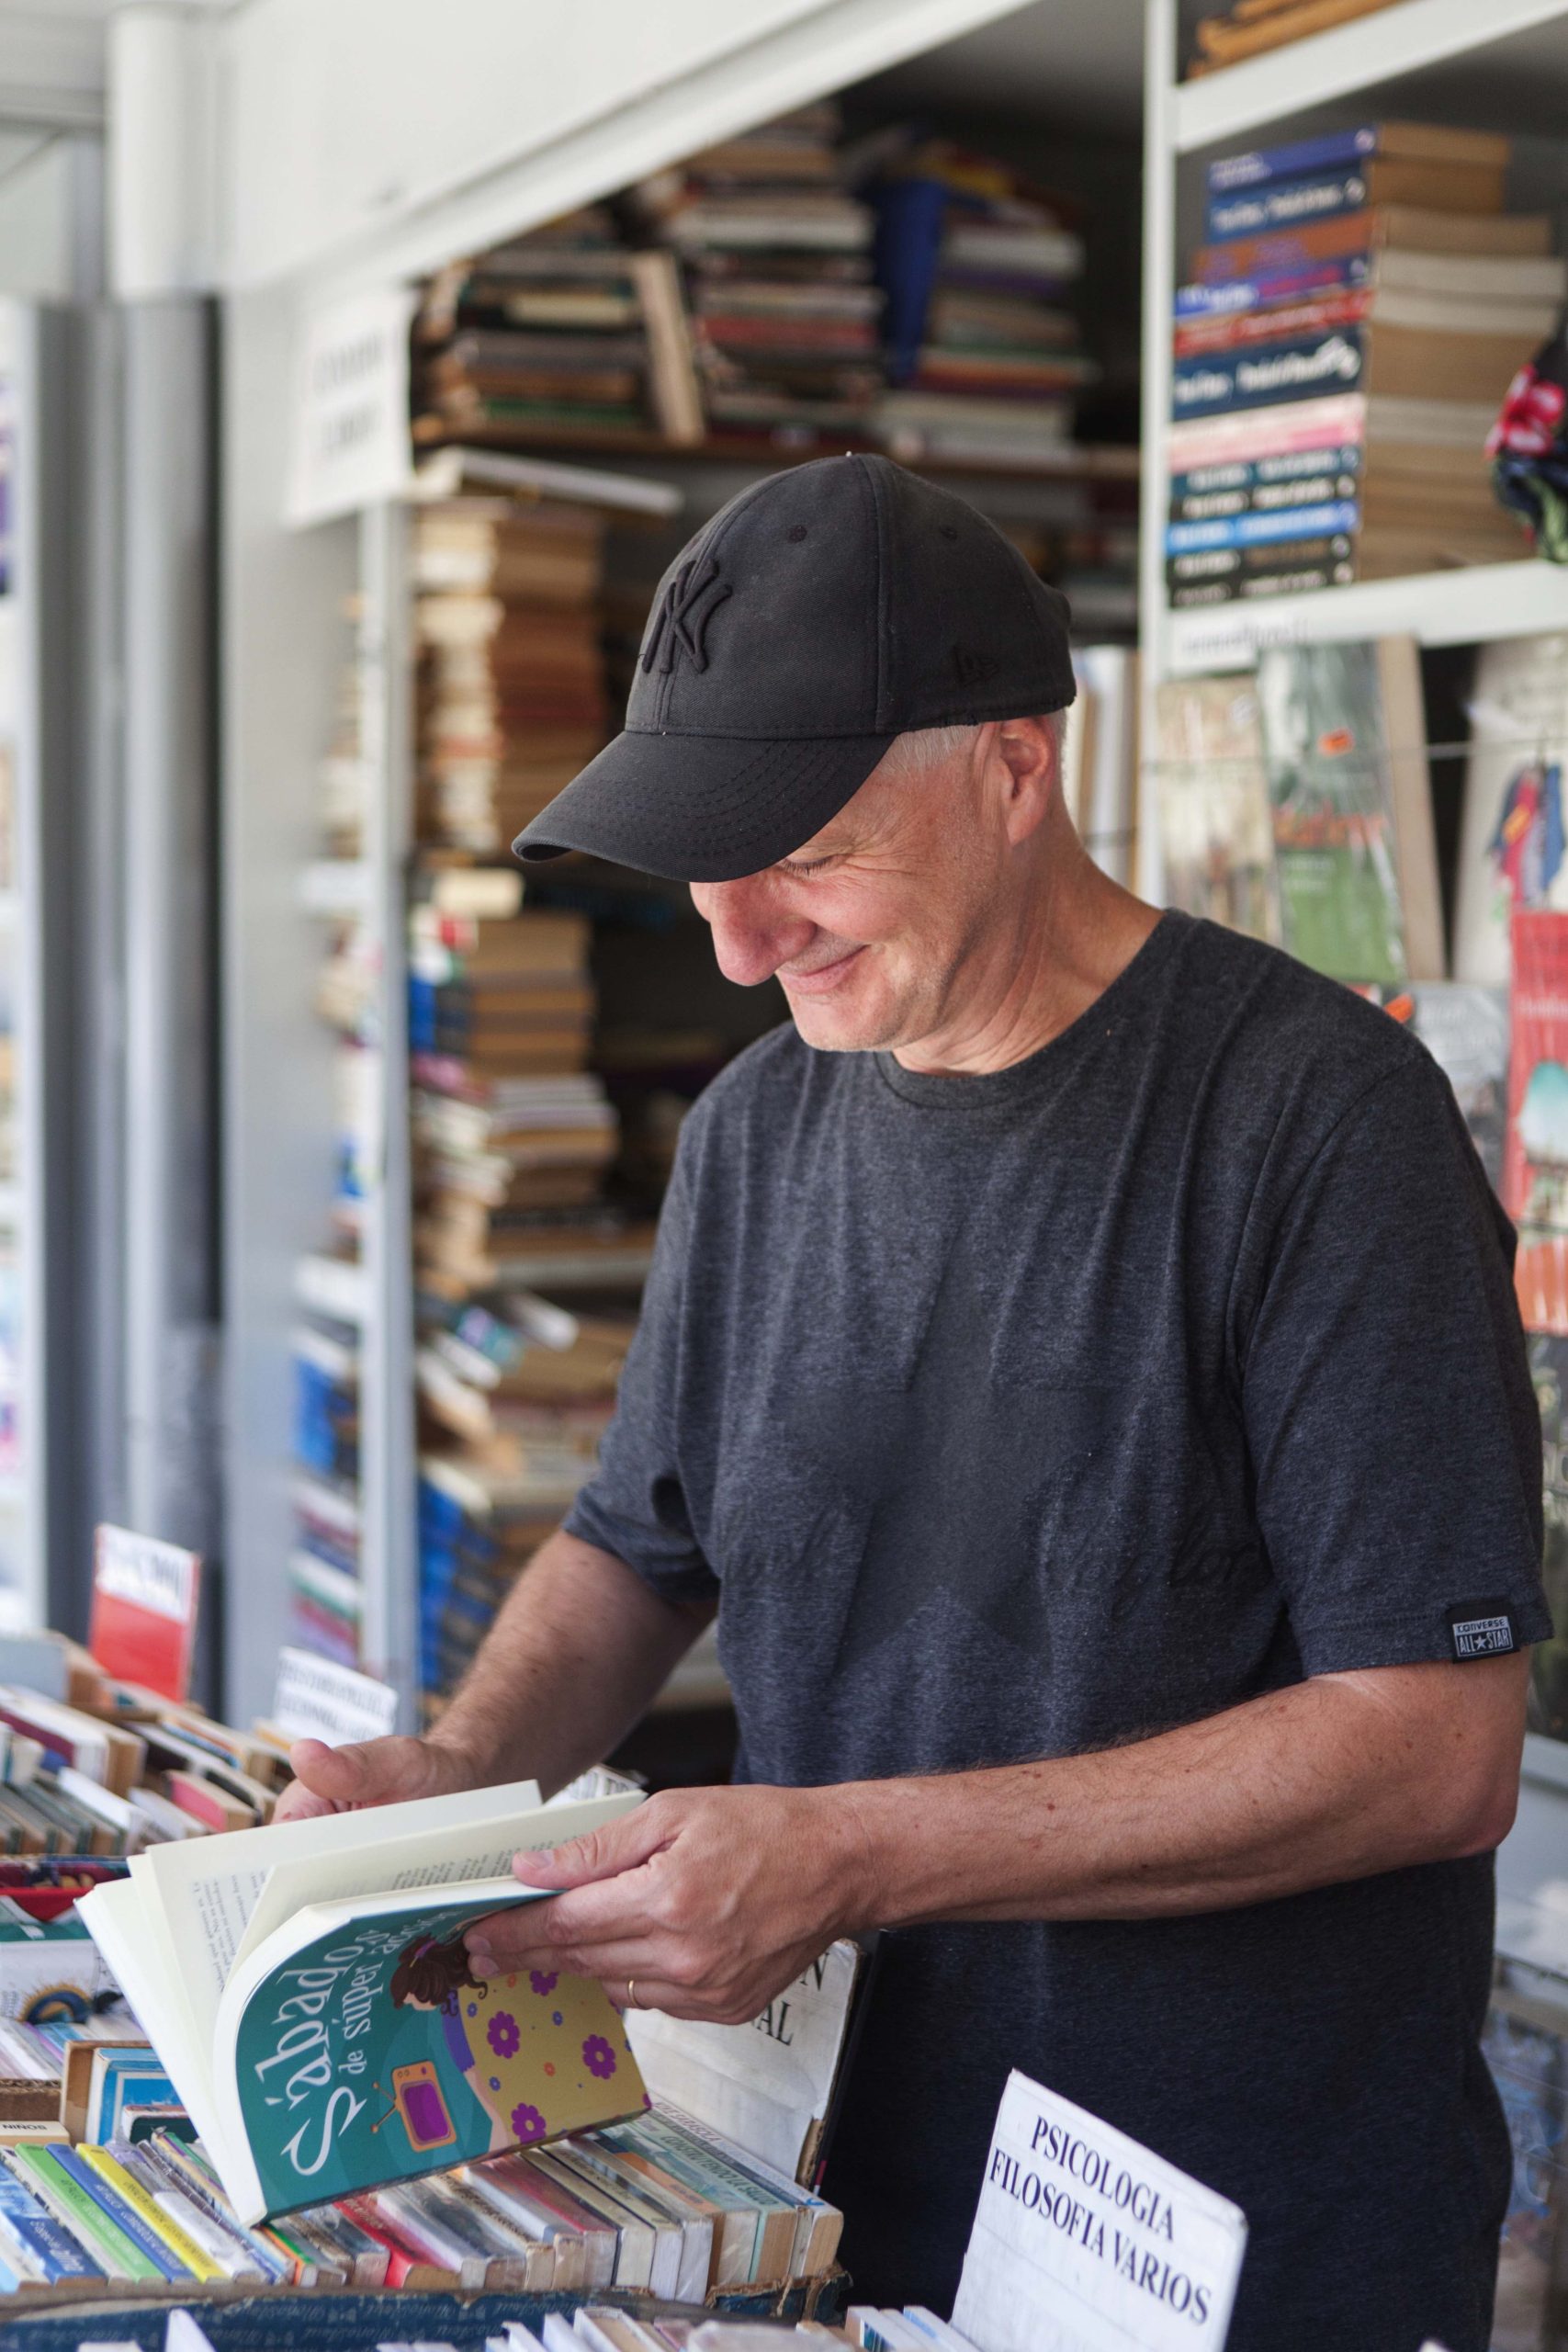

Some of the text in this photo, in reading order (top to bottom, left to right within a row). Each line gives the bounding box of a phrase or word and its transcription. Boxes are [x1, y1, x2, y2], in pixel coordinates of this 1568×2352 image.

[1457, 1618, 1506, 1633] CONVERSE
[332, 1960, 384, 2040] súper
[337, 2049, 367, 2075] de
[660, 2137, 738, 2177] CONSTRUYENDO
[1030, 2115, 1175, 2242] PSICOLOGIA
[989, 2146, 1213, 2325] FILOSOFIA VARIOS
